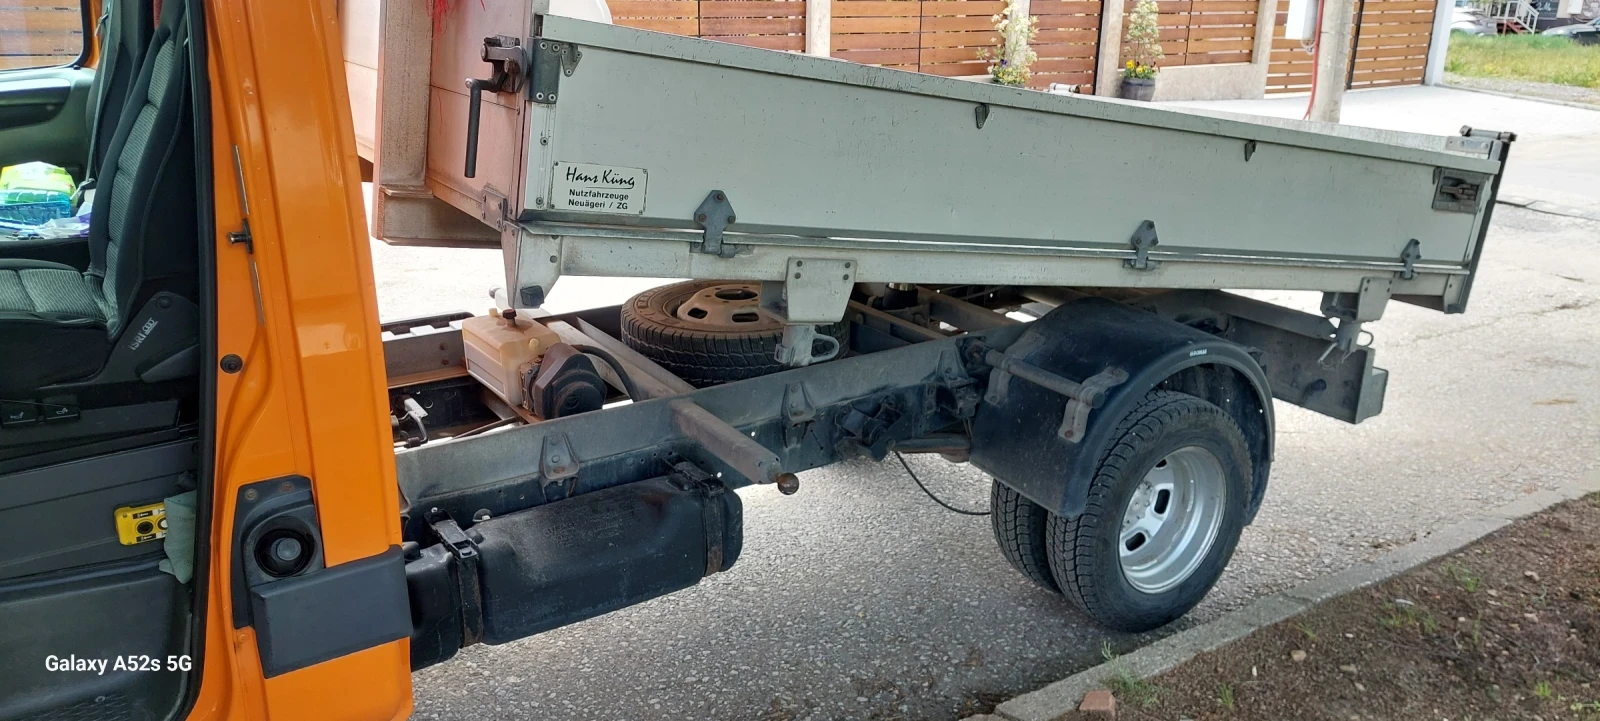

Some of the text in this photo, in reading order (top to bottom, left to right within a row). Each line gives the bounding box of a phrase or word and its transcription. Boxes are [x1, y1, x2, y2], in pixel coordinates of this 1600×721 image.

[566, 166, 635, 189] Hans Küng
[569, 188, 629, 201] Nutzfahrzeuge
[568, 199, 606, 209] Neuägeri
[616, 202, 629, 210] ZG
[128, 331, 147, 351] ISRI
